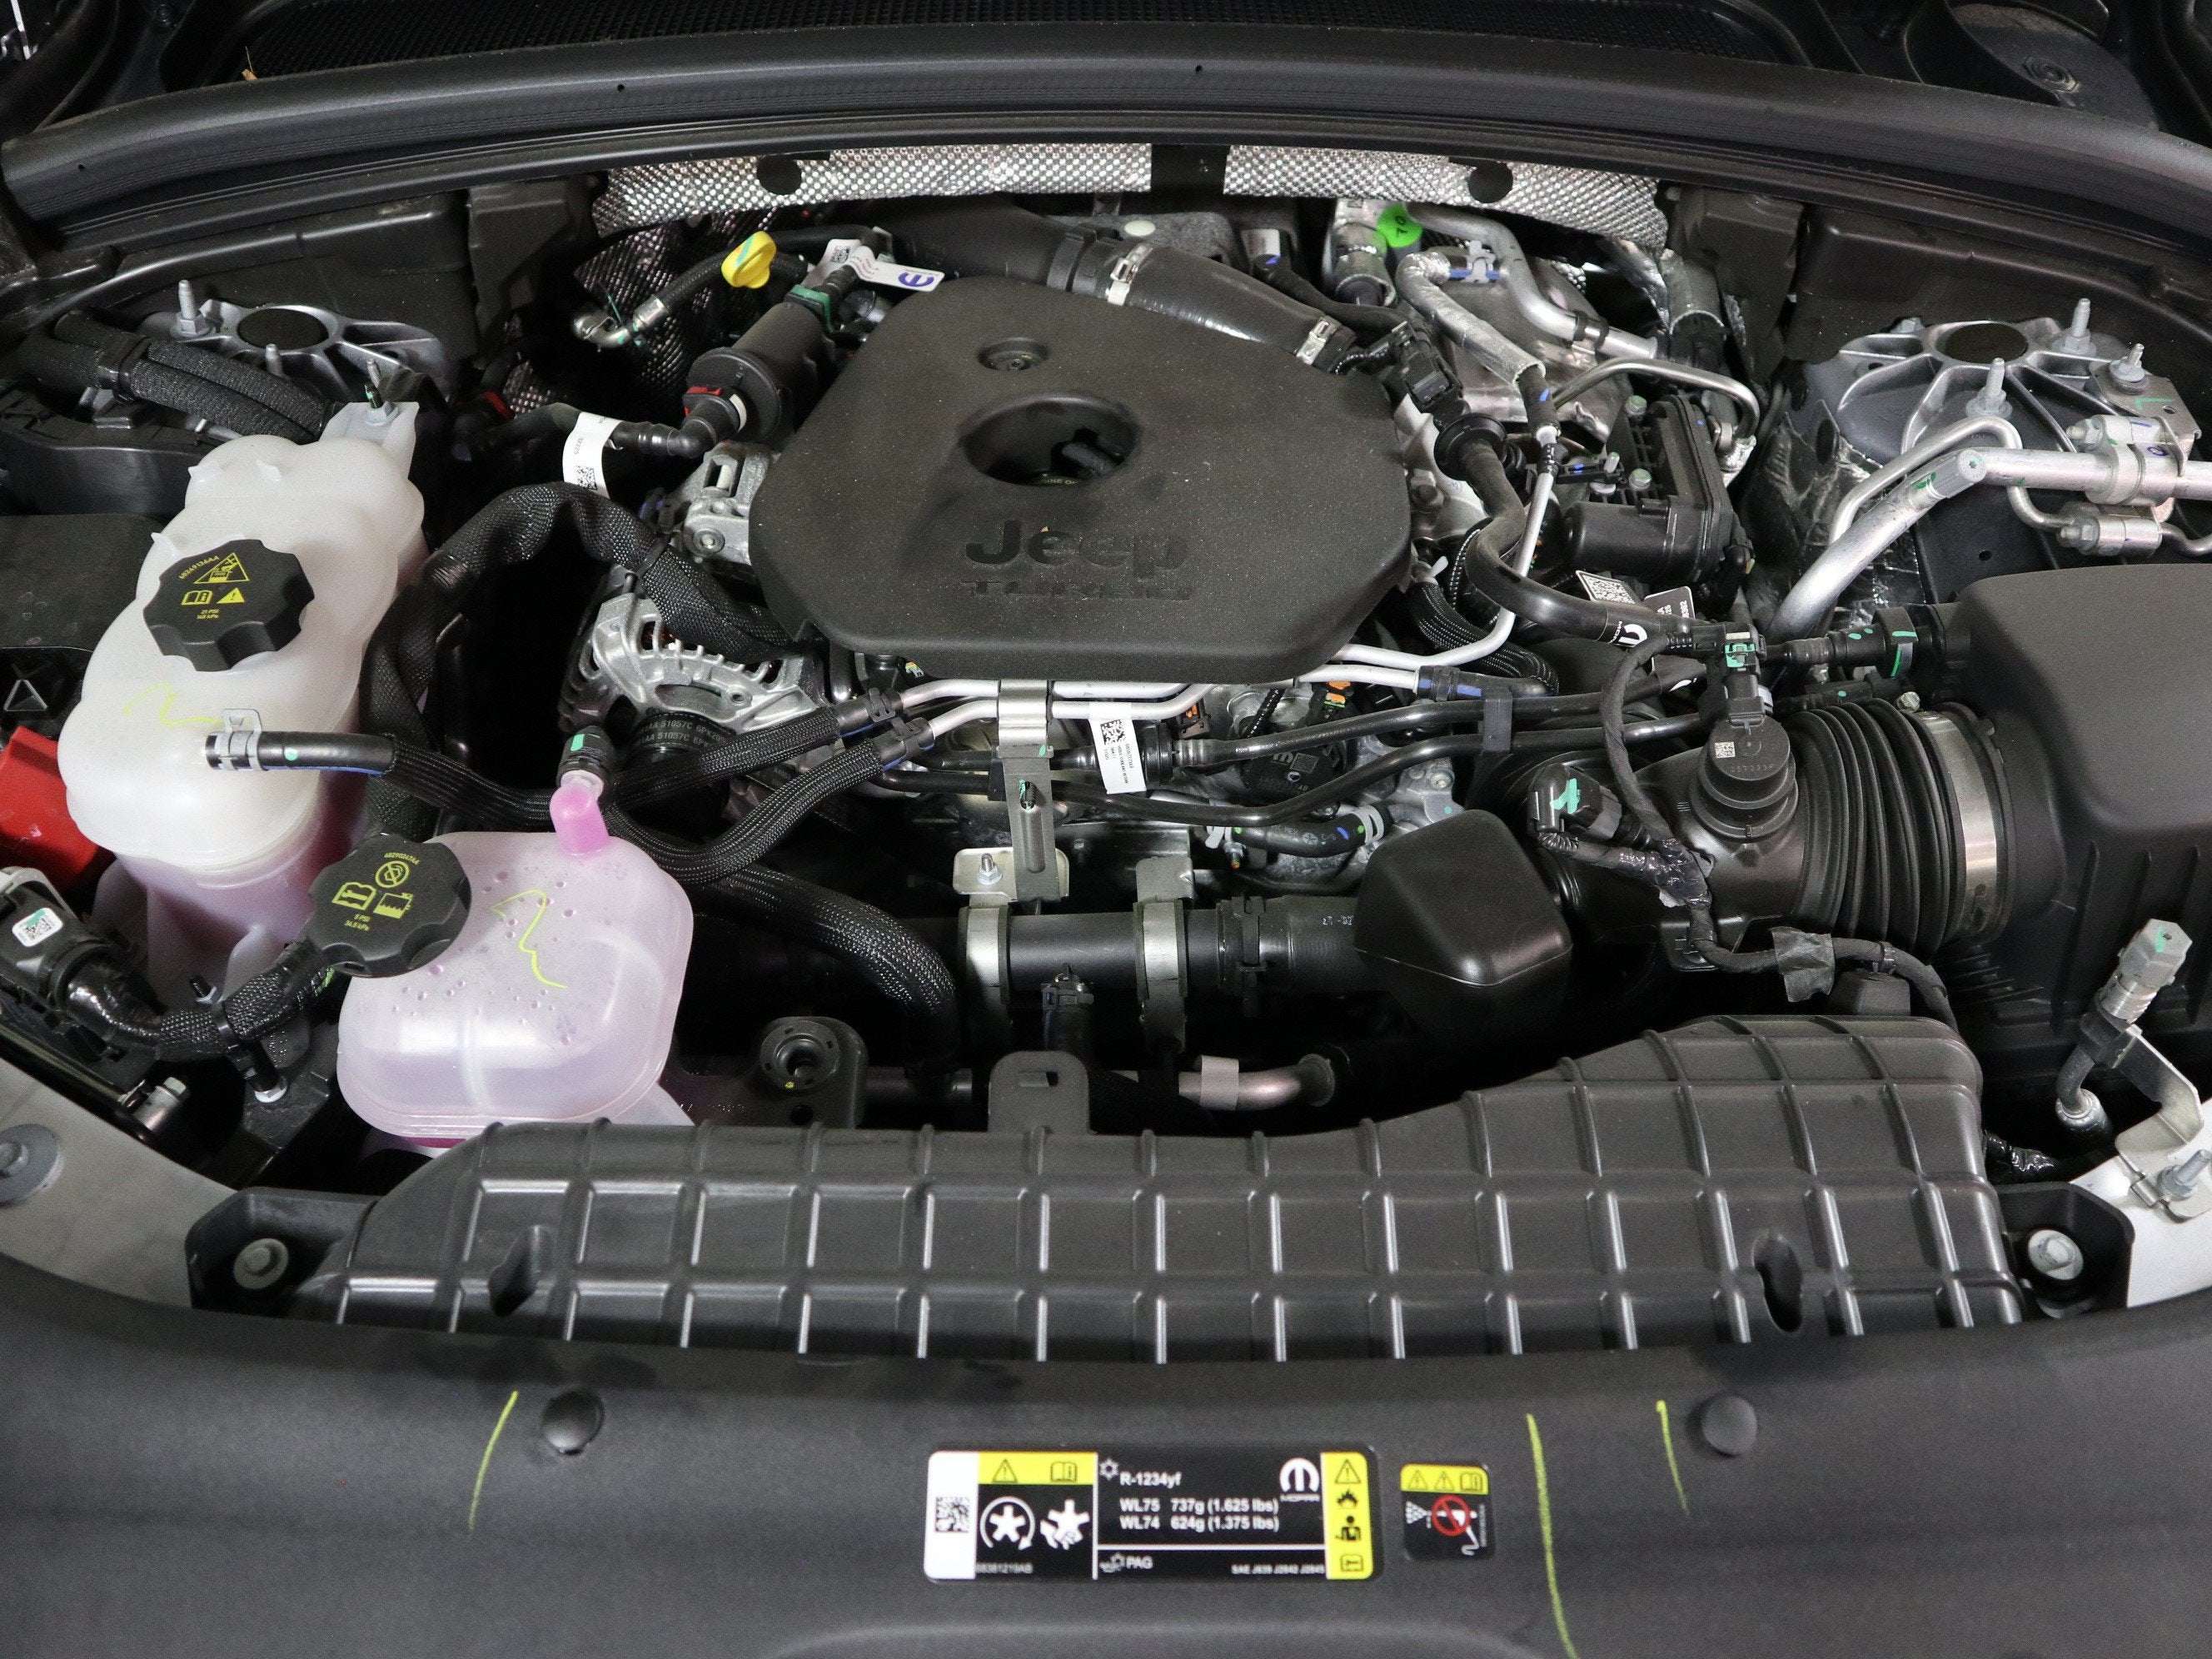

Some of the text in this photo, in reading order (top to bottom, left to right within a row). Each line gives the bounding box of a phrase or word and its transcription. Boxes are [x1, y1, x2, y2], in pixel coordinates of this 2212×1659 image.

[964, 519, 1188, 580] Jeep
[1119, 1471, 1183, 1489] R-1234yf
[1119, 1497, 1280, 1516] WL75 737g (1.625 lbs)
[1119, 1515, 1280, 1533] WL74 624g (1.375 lbs)
[1125, 1555, 1154, 1570] PAG
